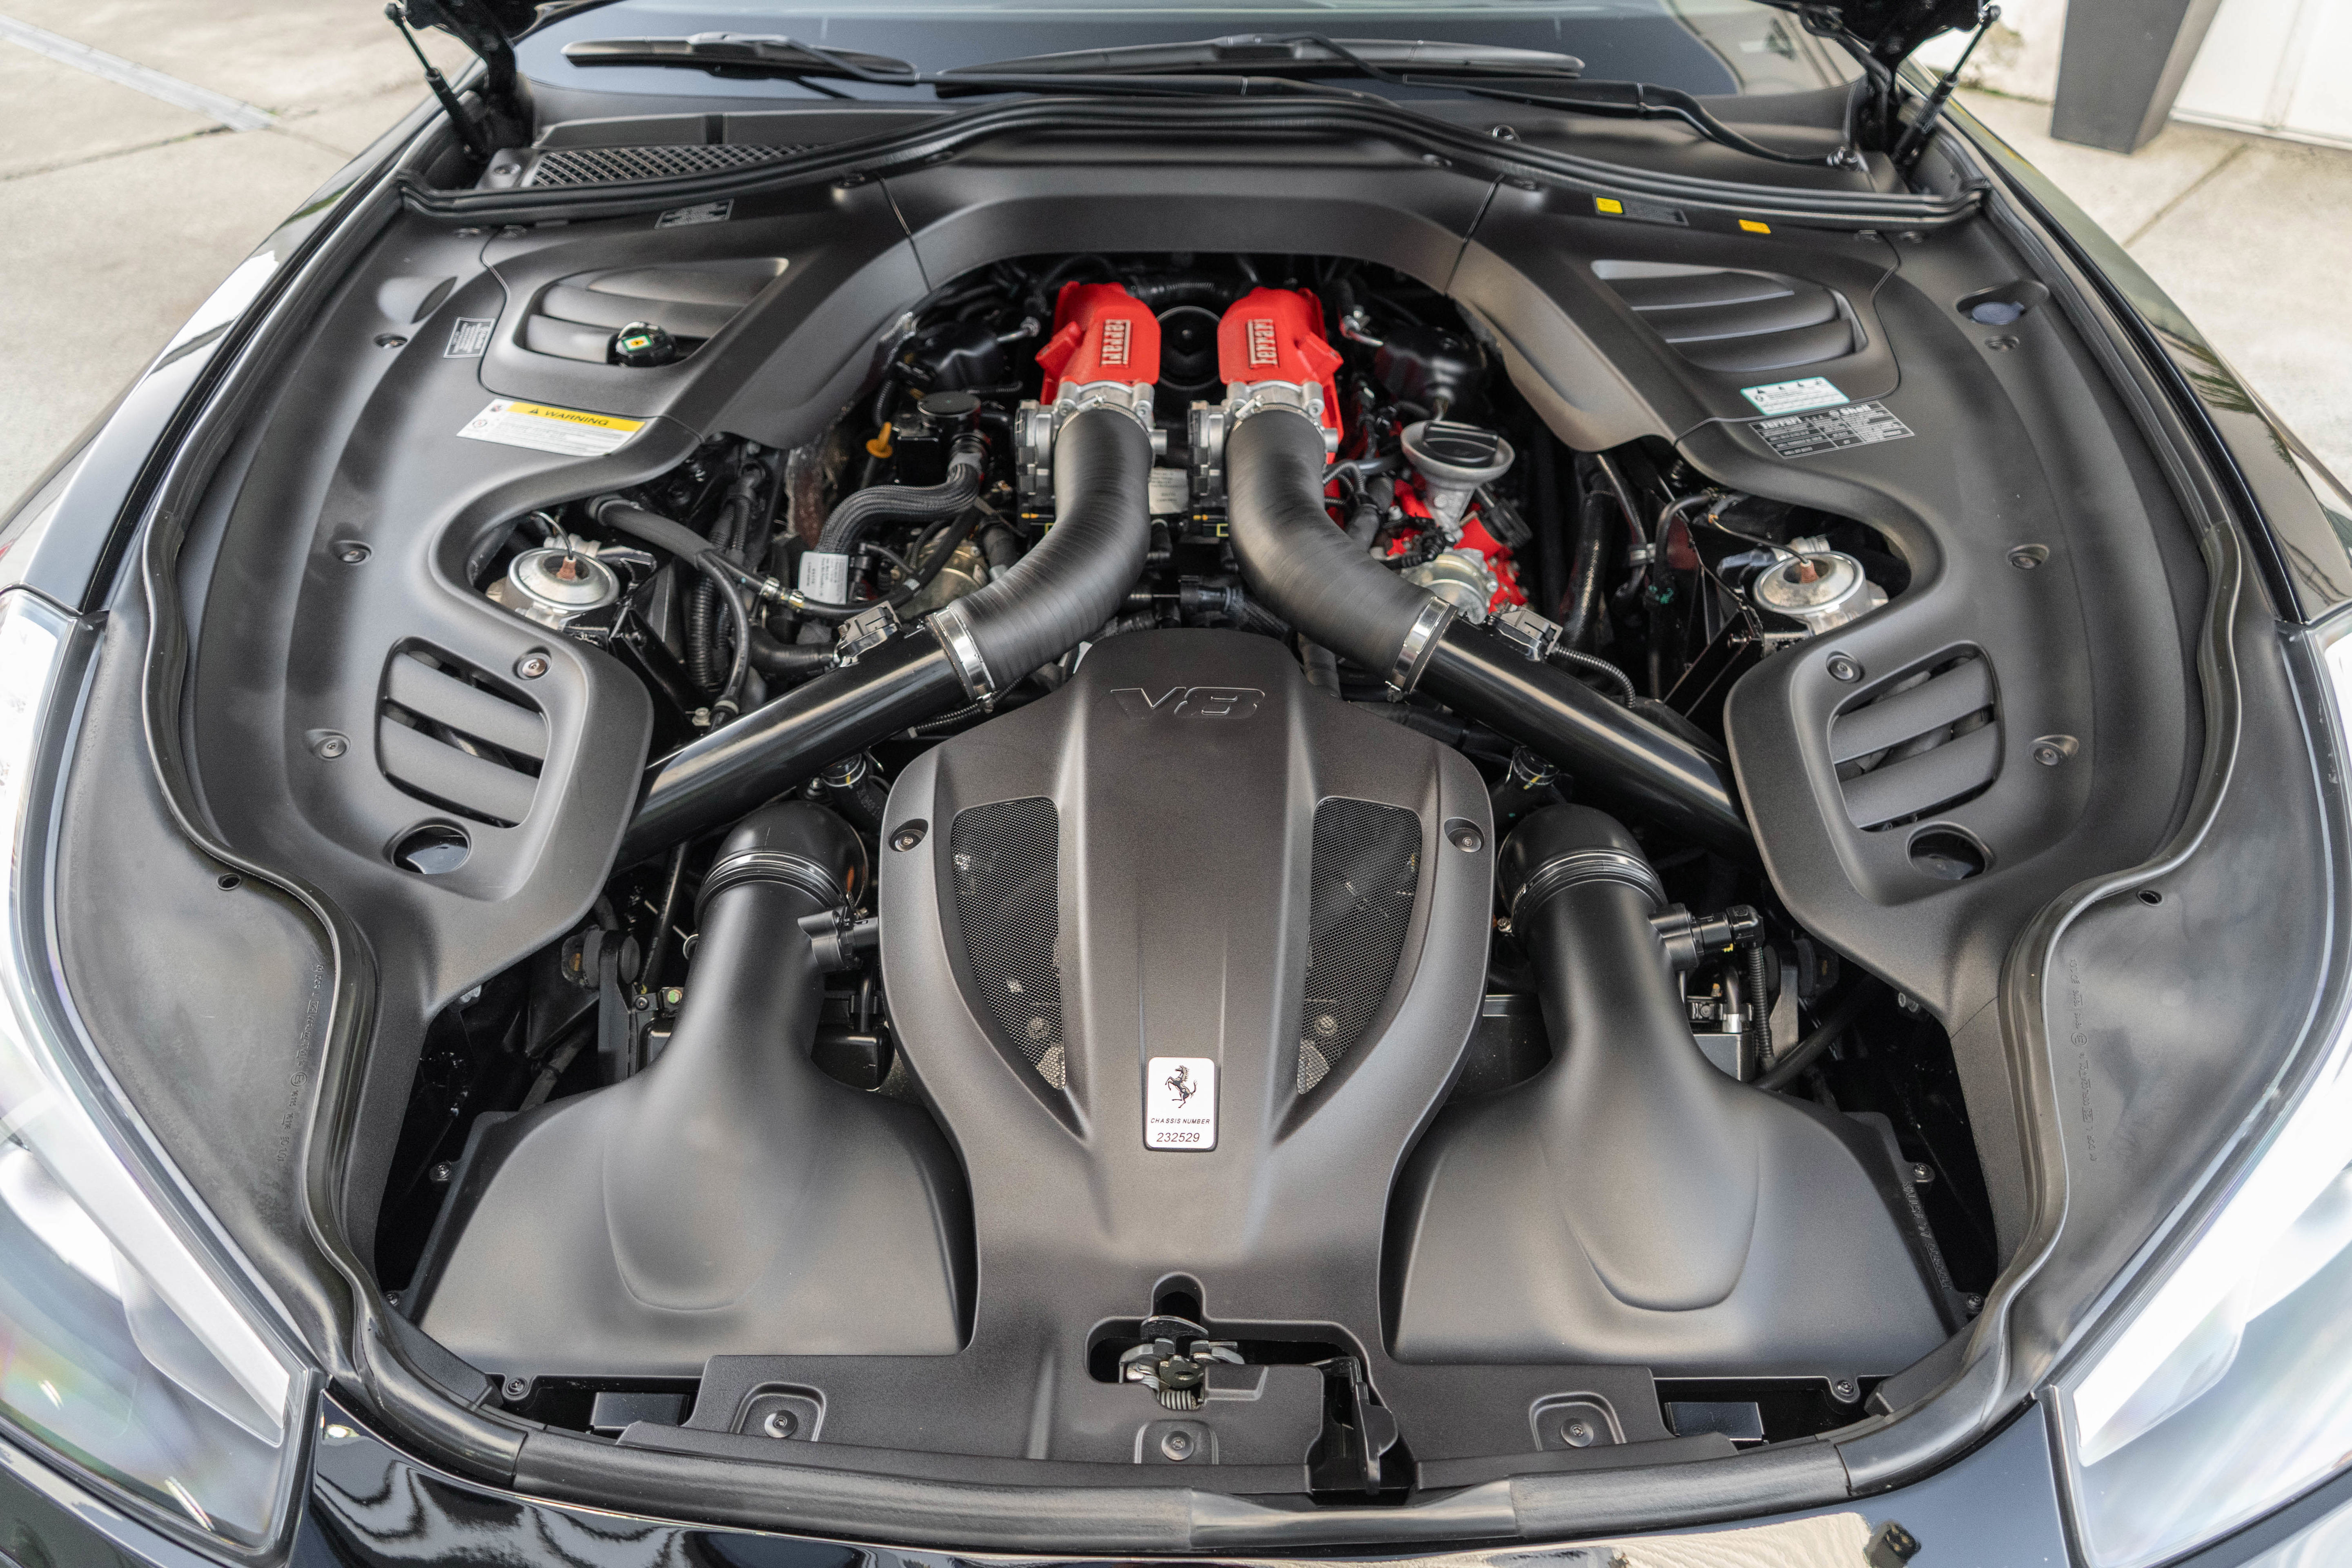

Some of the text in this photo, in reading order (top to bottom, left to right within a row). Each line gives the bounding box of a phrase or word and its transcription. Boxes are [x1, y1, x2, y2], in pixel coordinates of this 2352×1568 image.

[1840, 404, 1871, 415] Shell
[546, 411, 610, 426] WARNING
[1111, 686, 1265, 719] V8
[1156, 1133, 1200, 1142] 232529
